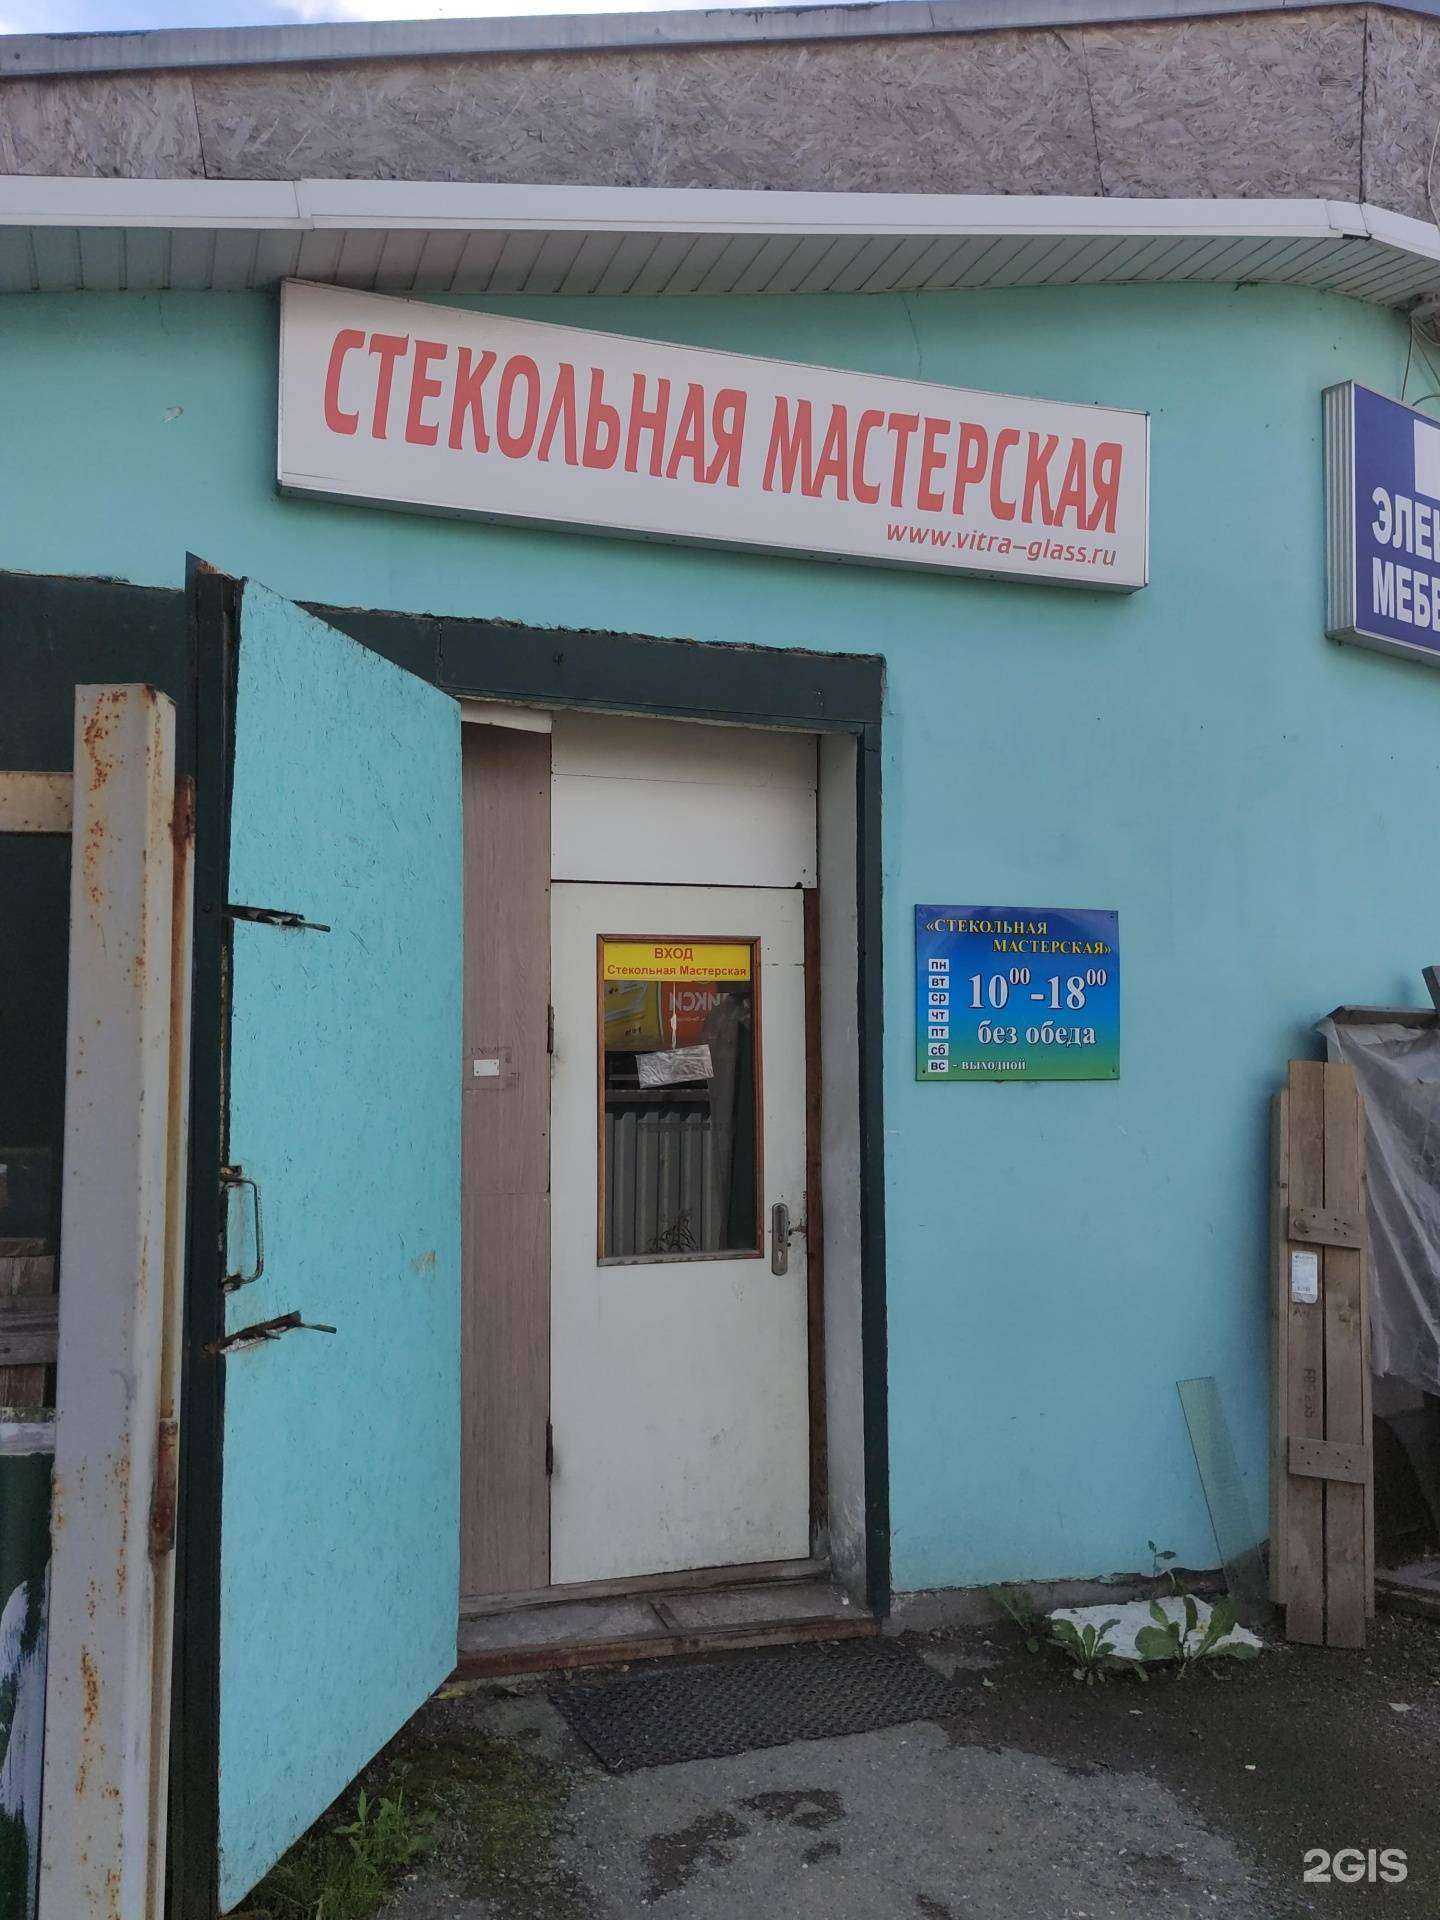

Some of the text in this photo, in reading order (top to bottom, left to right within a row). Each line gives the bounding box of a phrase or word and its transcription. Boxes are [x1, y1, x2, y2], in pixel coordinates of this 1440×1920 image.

[324, 327, 1124, 535] СТЕКОЛЬНАЯ МАСТЕРСКАЯ
[886, 522, 1117, 567] www.vitra-glass.ru
[654, 947, 694, 961] ВХОД
[607, 964, 747, 977] Стекольная Мастерская
[977, 1019, 1097, 1047] без обеда
[930, 1043, 946, 1055] сб
[961, 1057, 1026, 1073] выходной
